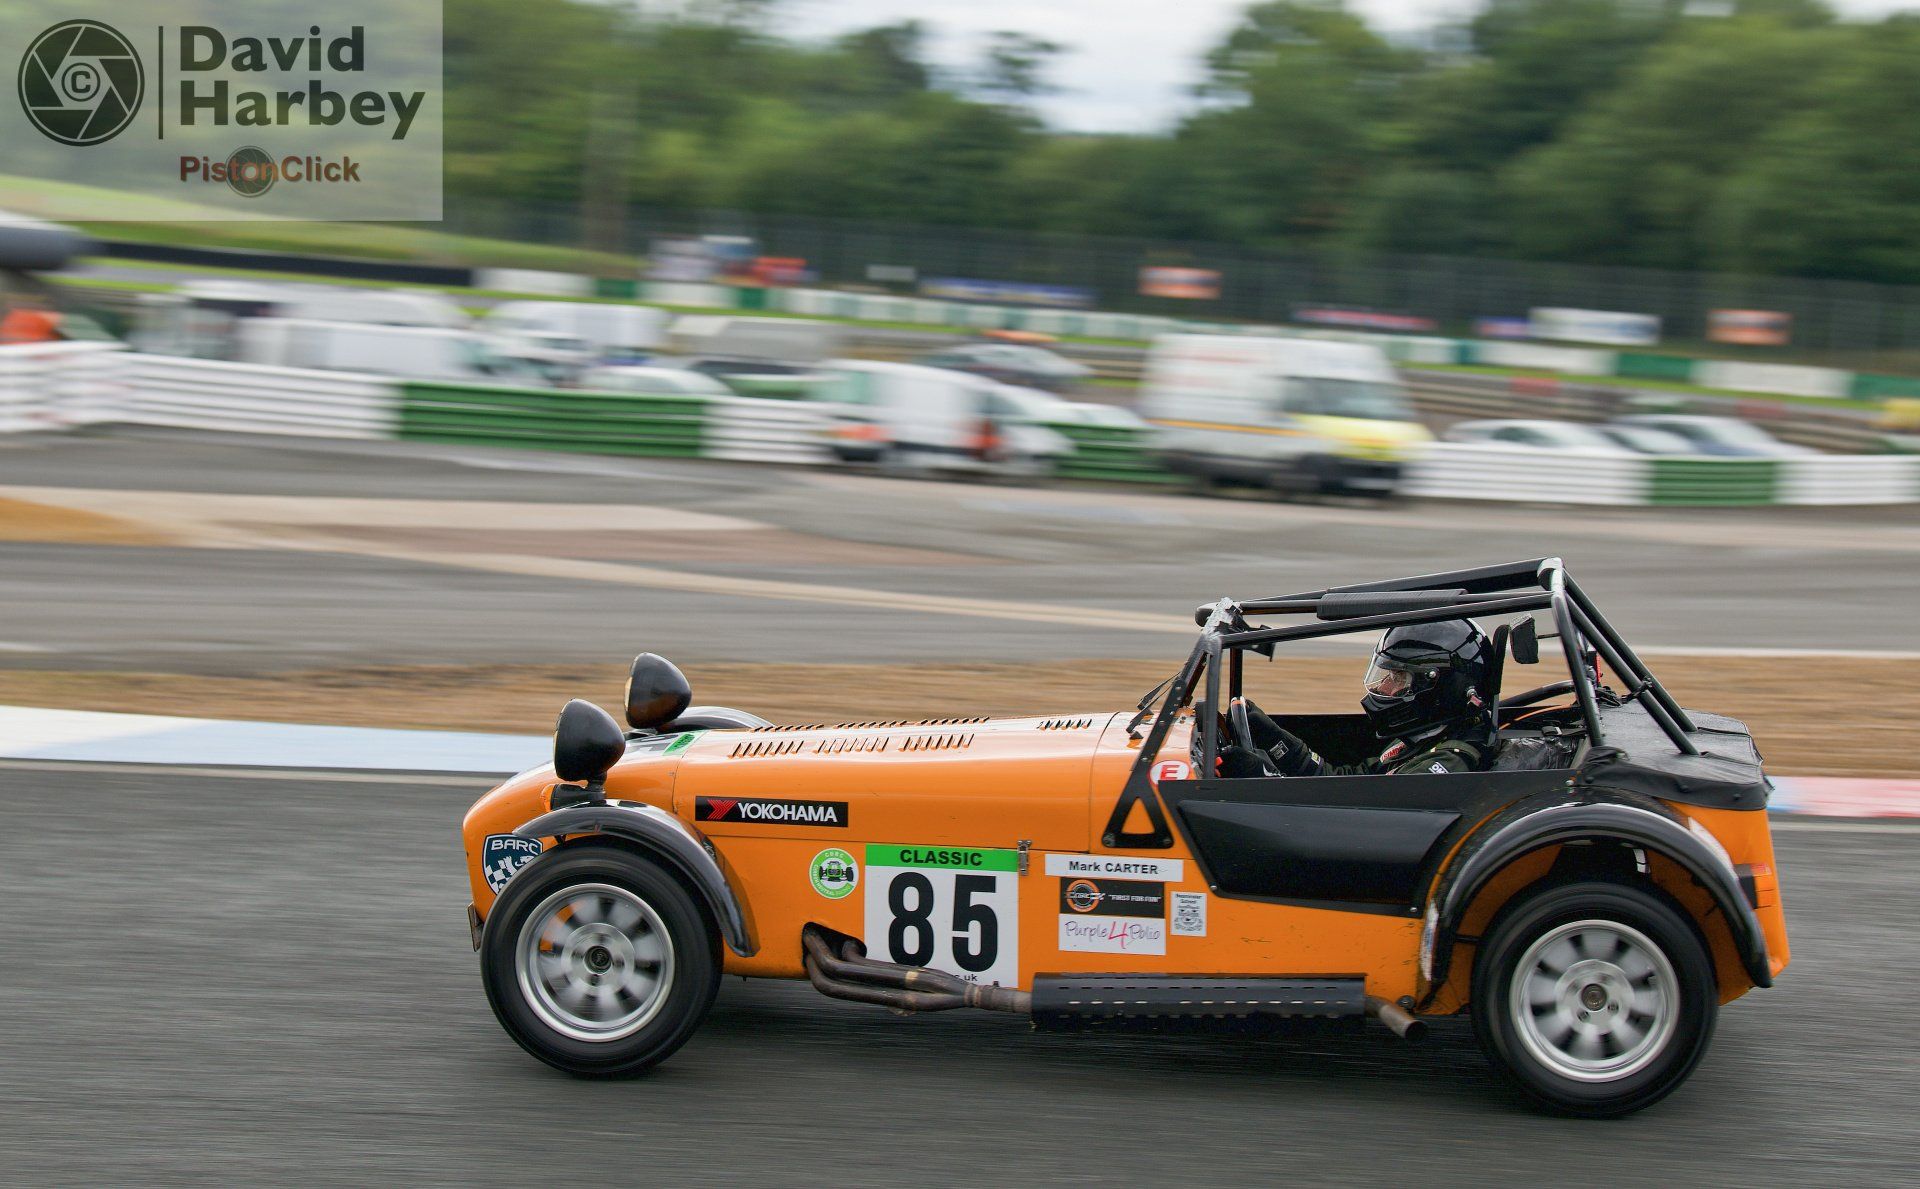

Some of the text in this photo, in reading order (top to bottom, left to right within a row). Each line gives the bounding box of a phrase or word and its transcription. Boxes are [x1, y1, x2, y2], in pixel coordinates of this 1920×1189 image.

[1160, 765, 1180, 781] E
[737, 802, 838, 823] YOKOHAMA
[490, 839, 539, 856] BARC
[899, 849, 983, 867] CLASSIC
[1068, 861, 1159, 875] Mark CARTER
[888, 871, 999, 973] 85
[1064, 920, 1161, 949] Purple 4 Polio
